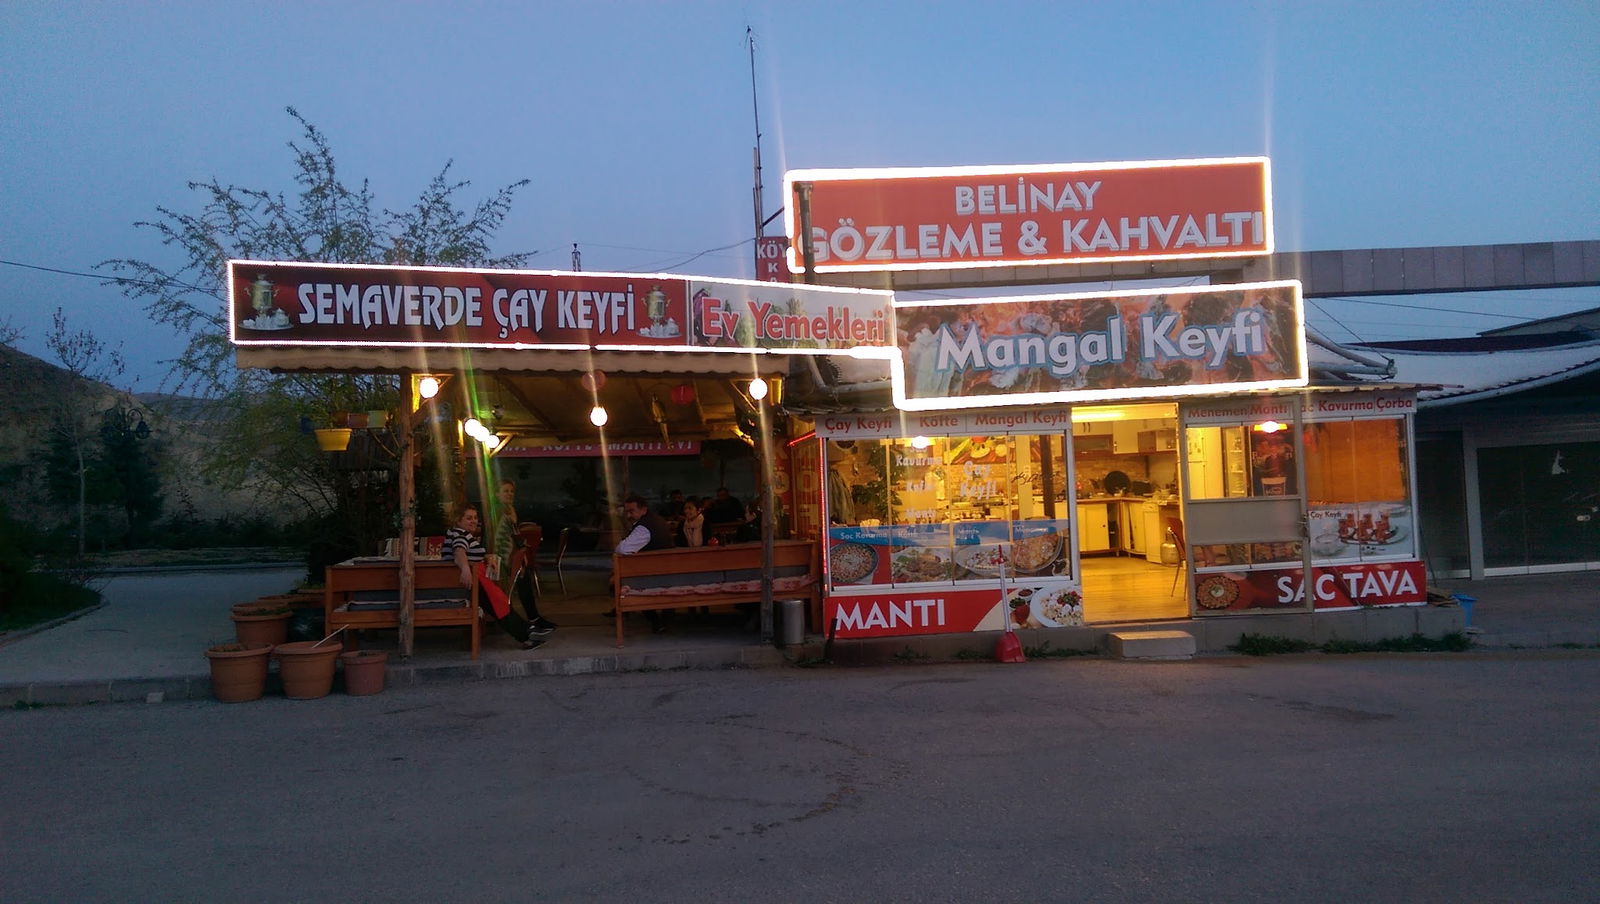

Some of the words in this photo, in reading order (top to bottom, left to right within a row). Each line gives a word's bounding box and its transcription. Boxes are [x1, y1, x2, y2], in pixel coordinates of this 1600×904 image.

[955, 176, 1102, 215] BELİNAY
[797, 217, 1004, 262] GÖZLEME
[1017, 220, 1047, 256] &
[1062, 210, 1265, 253] KAHVALTI
[298, 282, 484, 331] SEMAVERDE
[492, 287, 548, 339] ÇAY
[557, 283, 636, 335] KEYFİ
[702, 296, 740, 339] Ev
[747, 300, 886, 342] Yemekleri
[935, 314, 1127, 377] Mangal
[1140, 306, 1266, 370] Keyfi
[975, 410, 1028, 428] Mangal
[1033, 409, 1067, 427] Keyfi
[1187, 407, 1248, 418] Menemen
[1318, 399, 1374, 412] Kavurma
[1376, 397, 1413, 412] Çorba
[824, 417, 852, 434] Çay
[857, 415, 893, 433] Keyfi
[919, 415, 959, 428] Köfte
[1342, 569, 1418, 599] TAVA
[835, 598, 946, 632] MANTI
